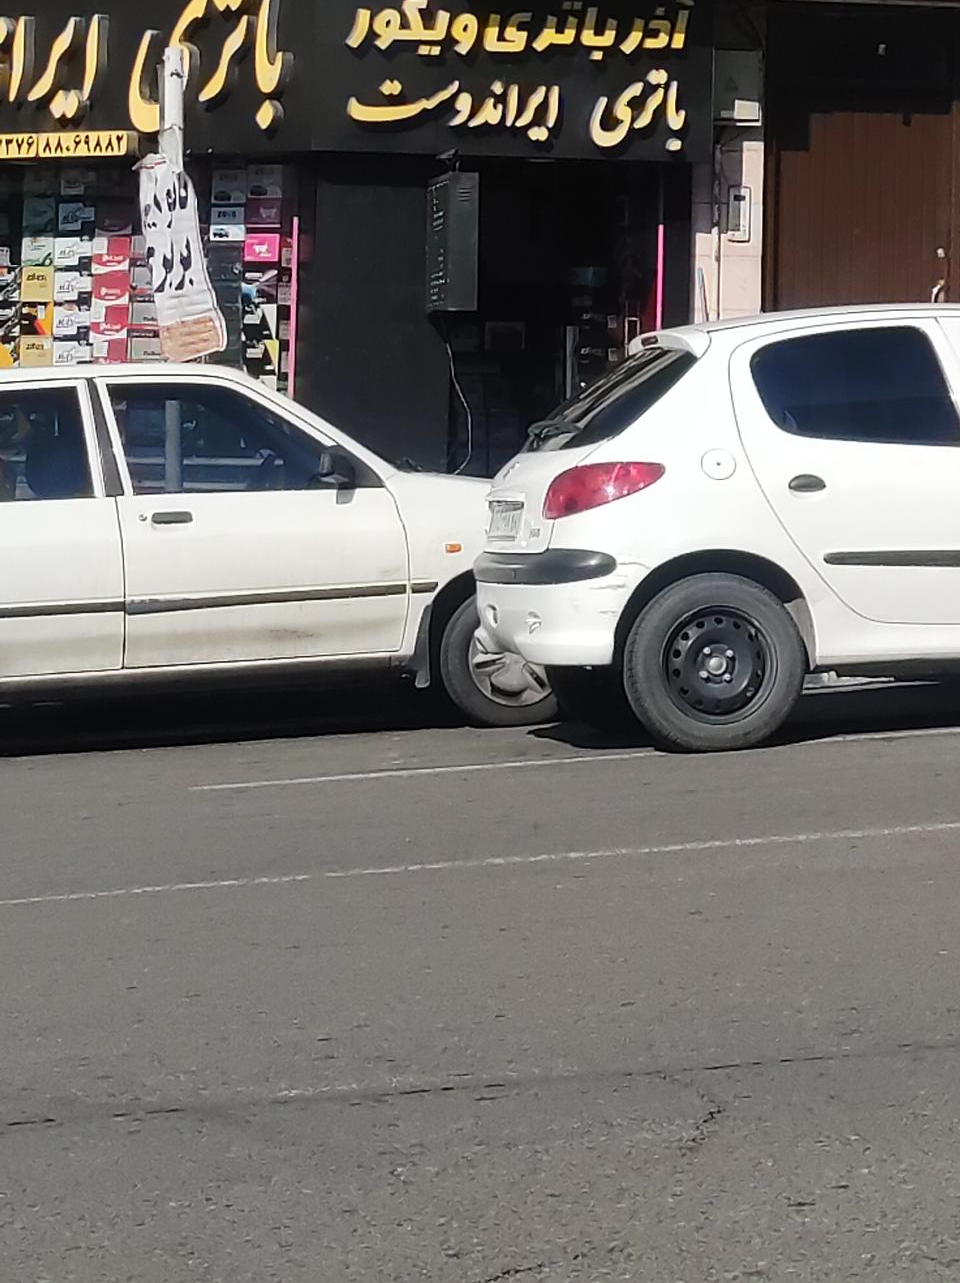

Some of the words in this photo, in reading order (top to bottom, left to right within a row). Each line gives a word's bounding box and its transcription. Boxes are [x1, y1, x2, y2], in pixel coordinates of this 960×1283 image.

[482, 1, 617, 61] باتری
[346, 78, 561, 143] ایراندوست
[588, 68, 687, 152] باتری
[43, 133, 124, 155] ۸۸۰۶۹۸۸۲
